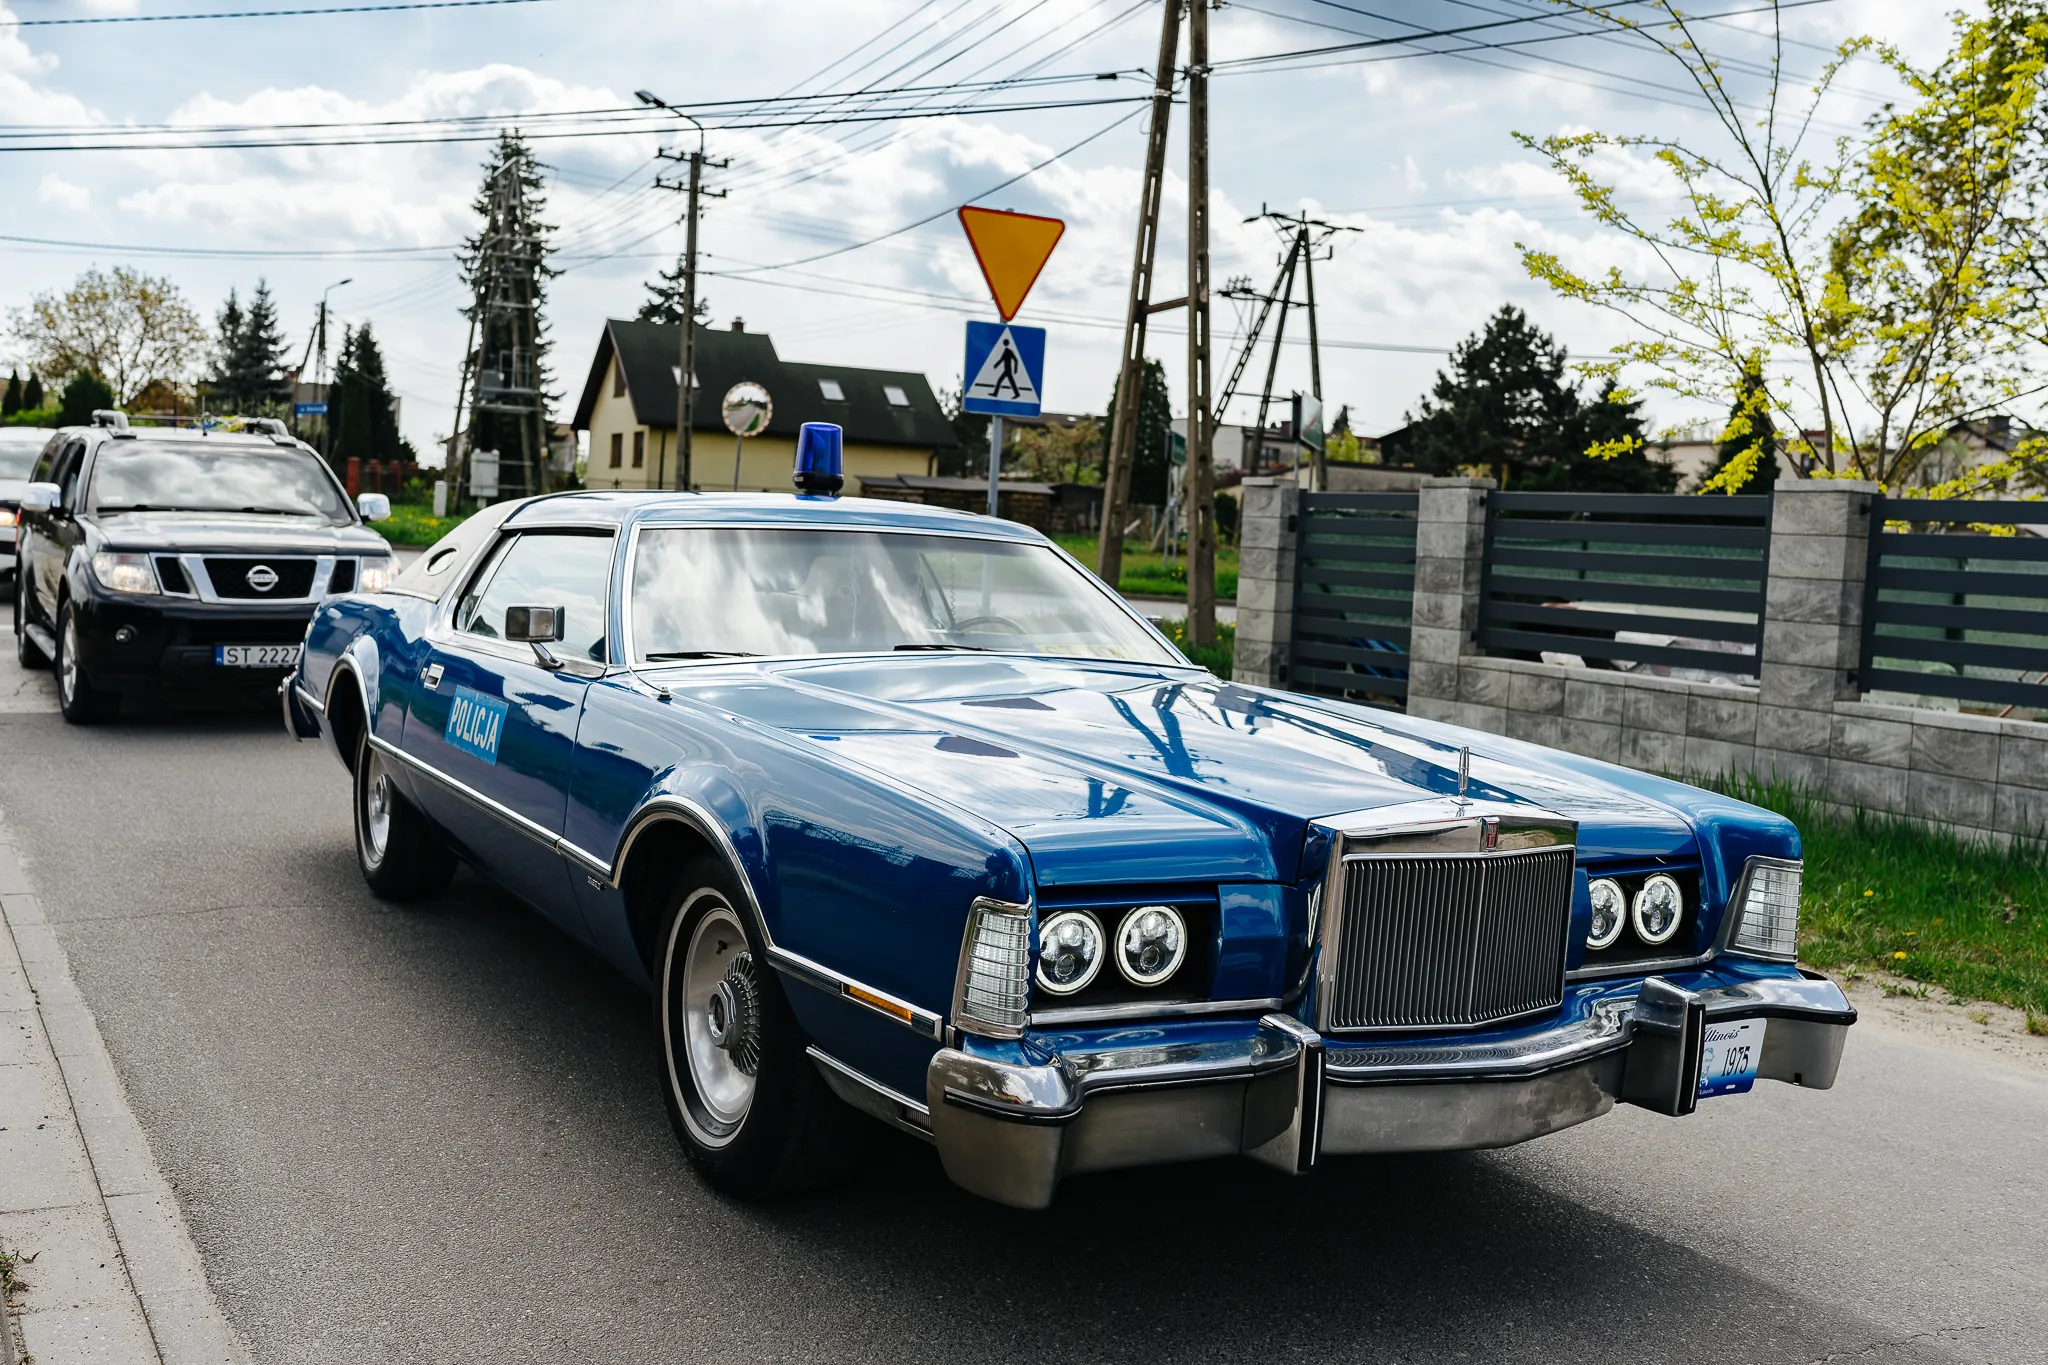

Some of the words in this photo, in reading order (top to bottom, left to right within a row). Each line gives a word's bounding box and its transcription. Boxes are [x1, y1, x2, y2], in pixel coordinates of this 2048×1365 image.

[227, 648, 251, 664] ST
[259, 648, 300, 664] 2227
[448, 696, 500, 753] POLICJA
[1721, 1046, 1750, 1076] 1975
